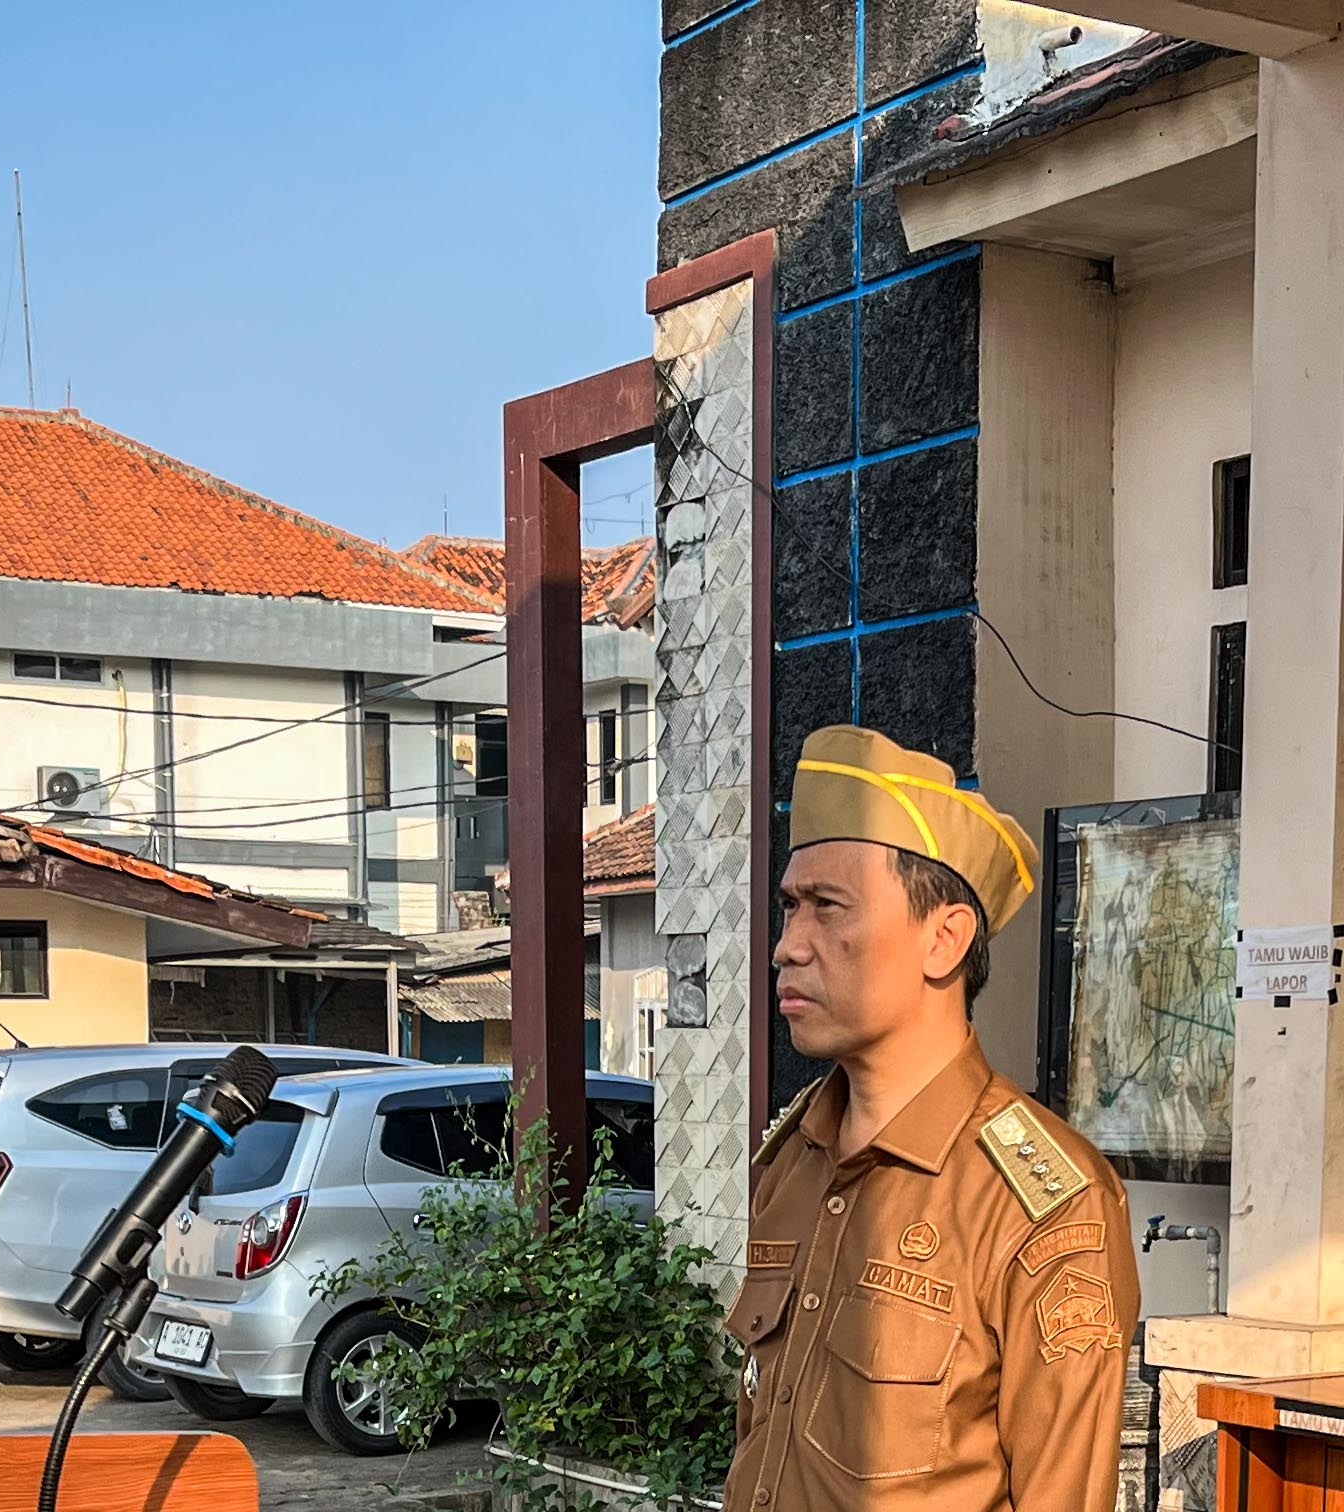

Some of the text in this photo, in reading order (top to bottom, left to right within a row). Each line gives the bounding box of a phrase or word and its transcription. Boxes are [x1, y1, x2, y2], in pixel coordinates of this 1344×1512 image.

[1248, 945, 1328, 962] TAMU WAJIB
[1266, 975, 1307, 990] LAPOR
[1282, 1410, 1322, 1430] TAMU
